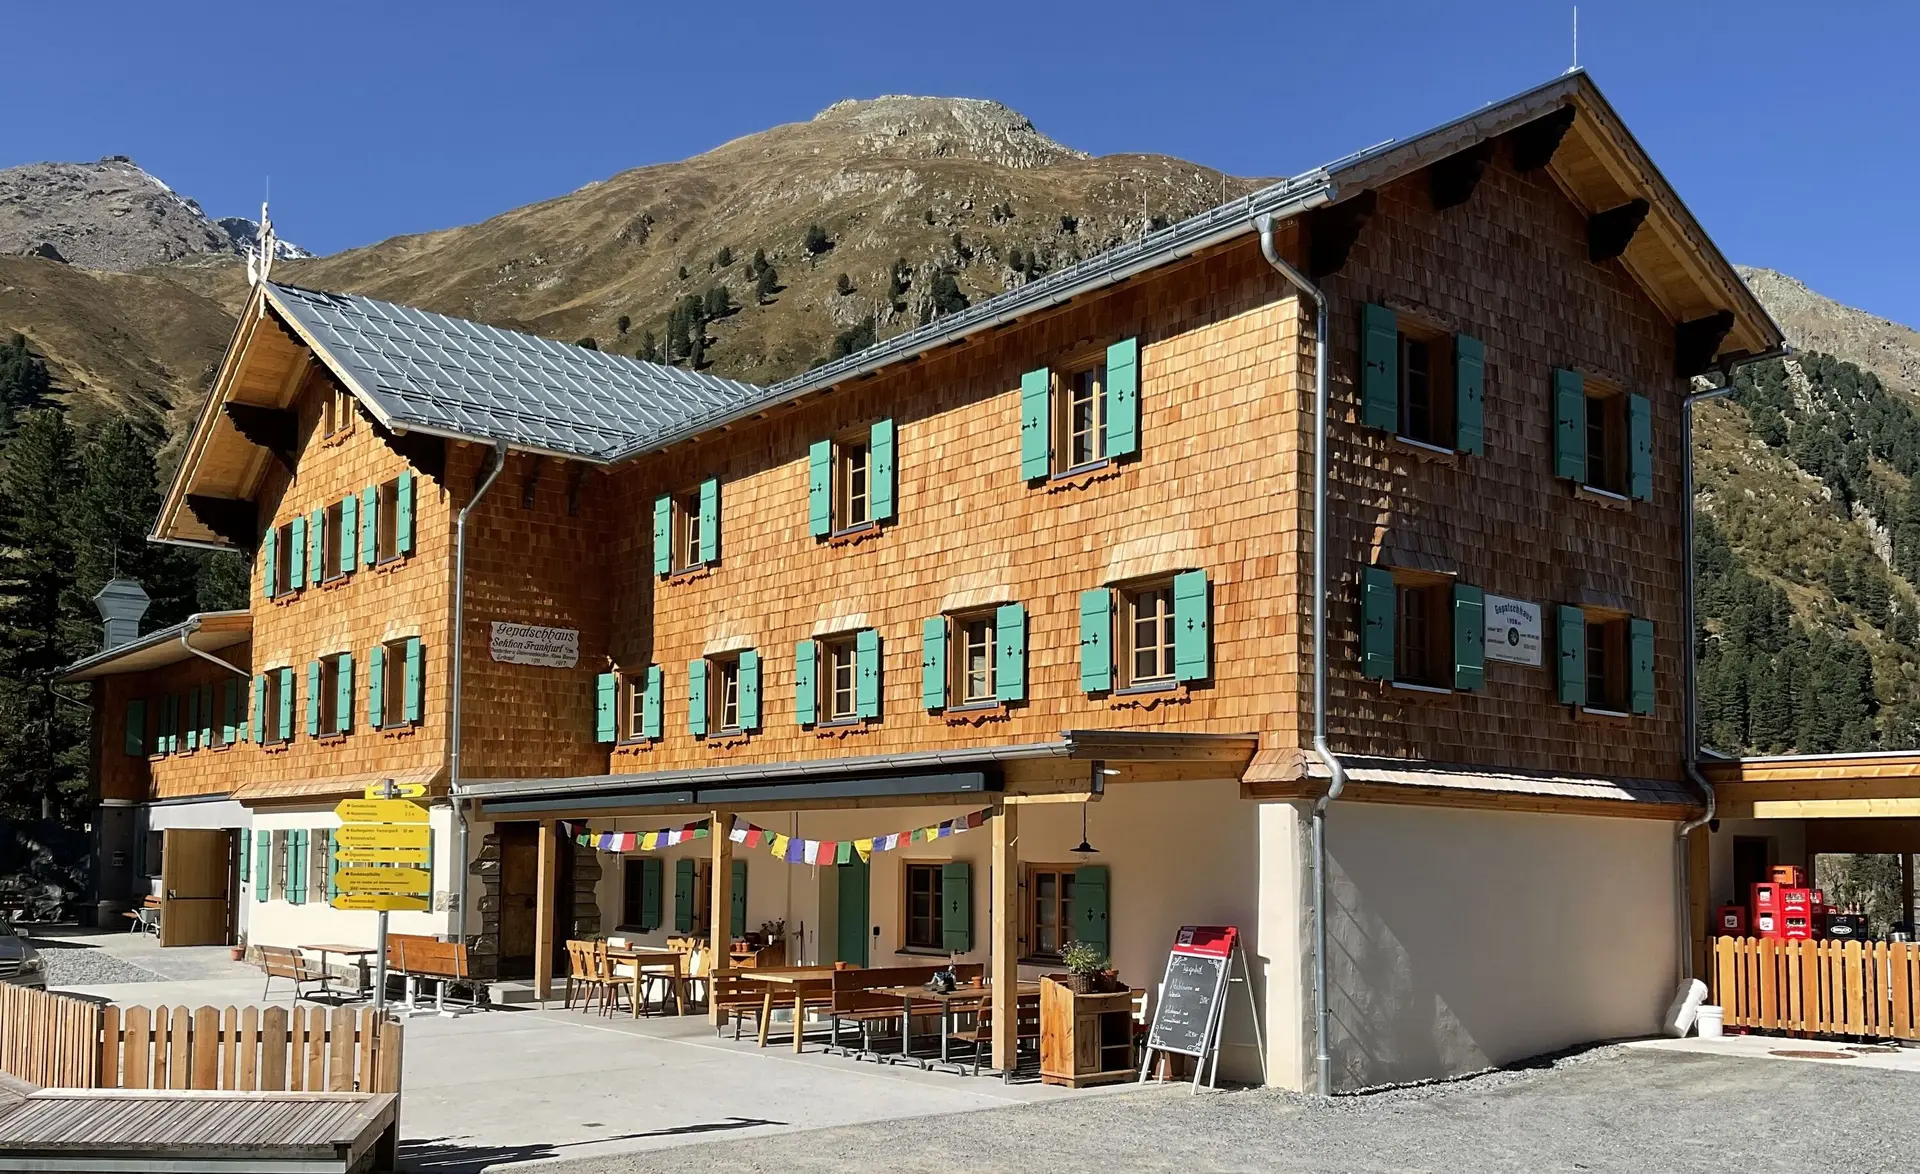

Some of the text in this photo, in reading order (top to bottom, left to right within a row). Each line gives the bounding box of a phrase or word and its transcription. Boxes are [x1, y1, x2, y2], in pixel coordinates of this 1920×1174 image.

[496, 622, 575, 643] Gepatschhaus
[492, 636, 523, 649] Sektion
[524, 640, 564, 654] Frankfurt
